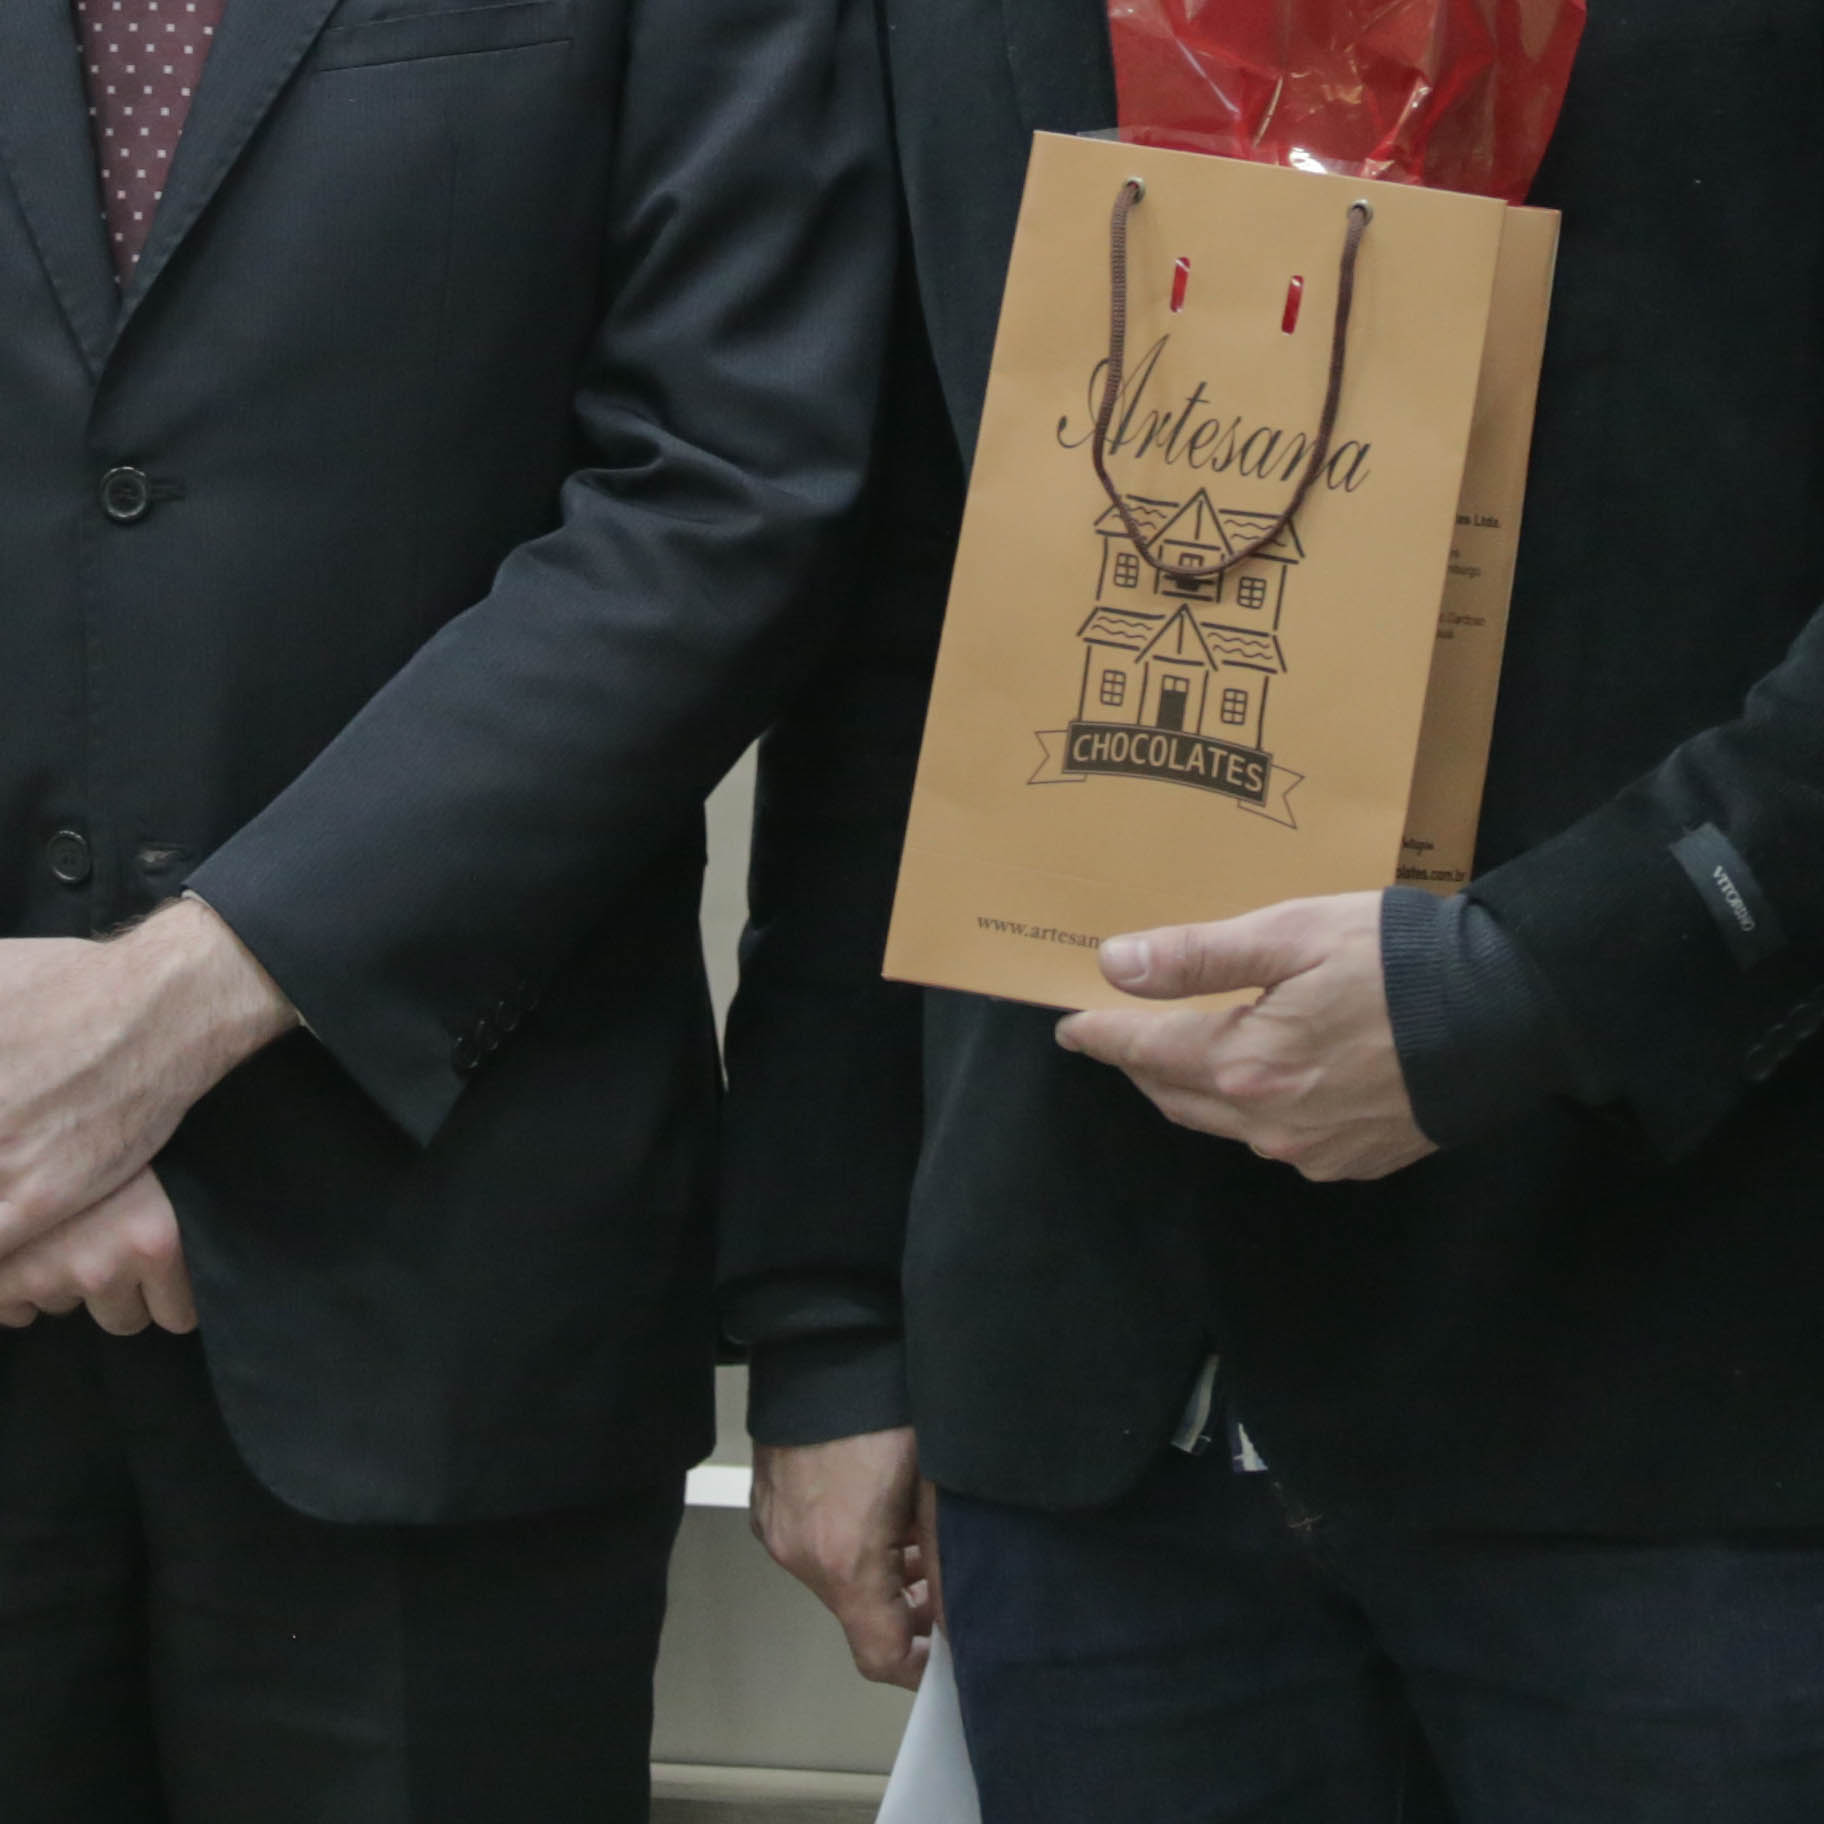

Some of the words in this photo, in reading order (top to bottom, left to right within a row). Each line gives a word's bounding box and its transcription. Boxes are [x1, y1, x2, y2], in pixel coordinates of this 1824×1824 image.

[1057, 333, 1371, 492] Artesana
[1072, 731, 1264, 794] CHOCOLATES
[977, 916, 1102, 950] www.artesan
